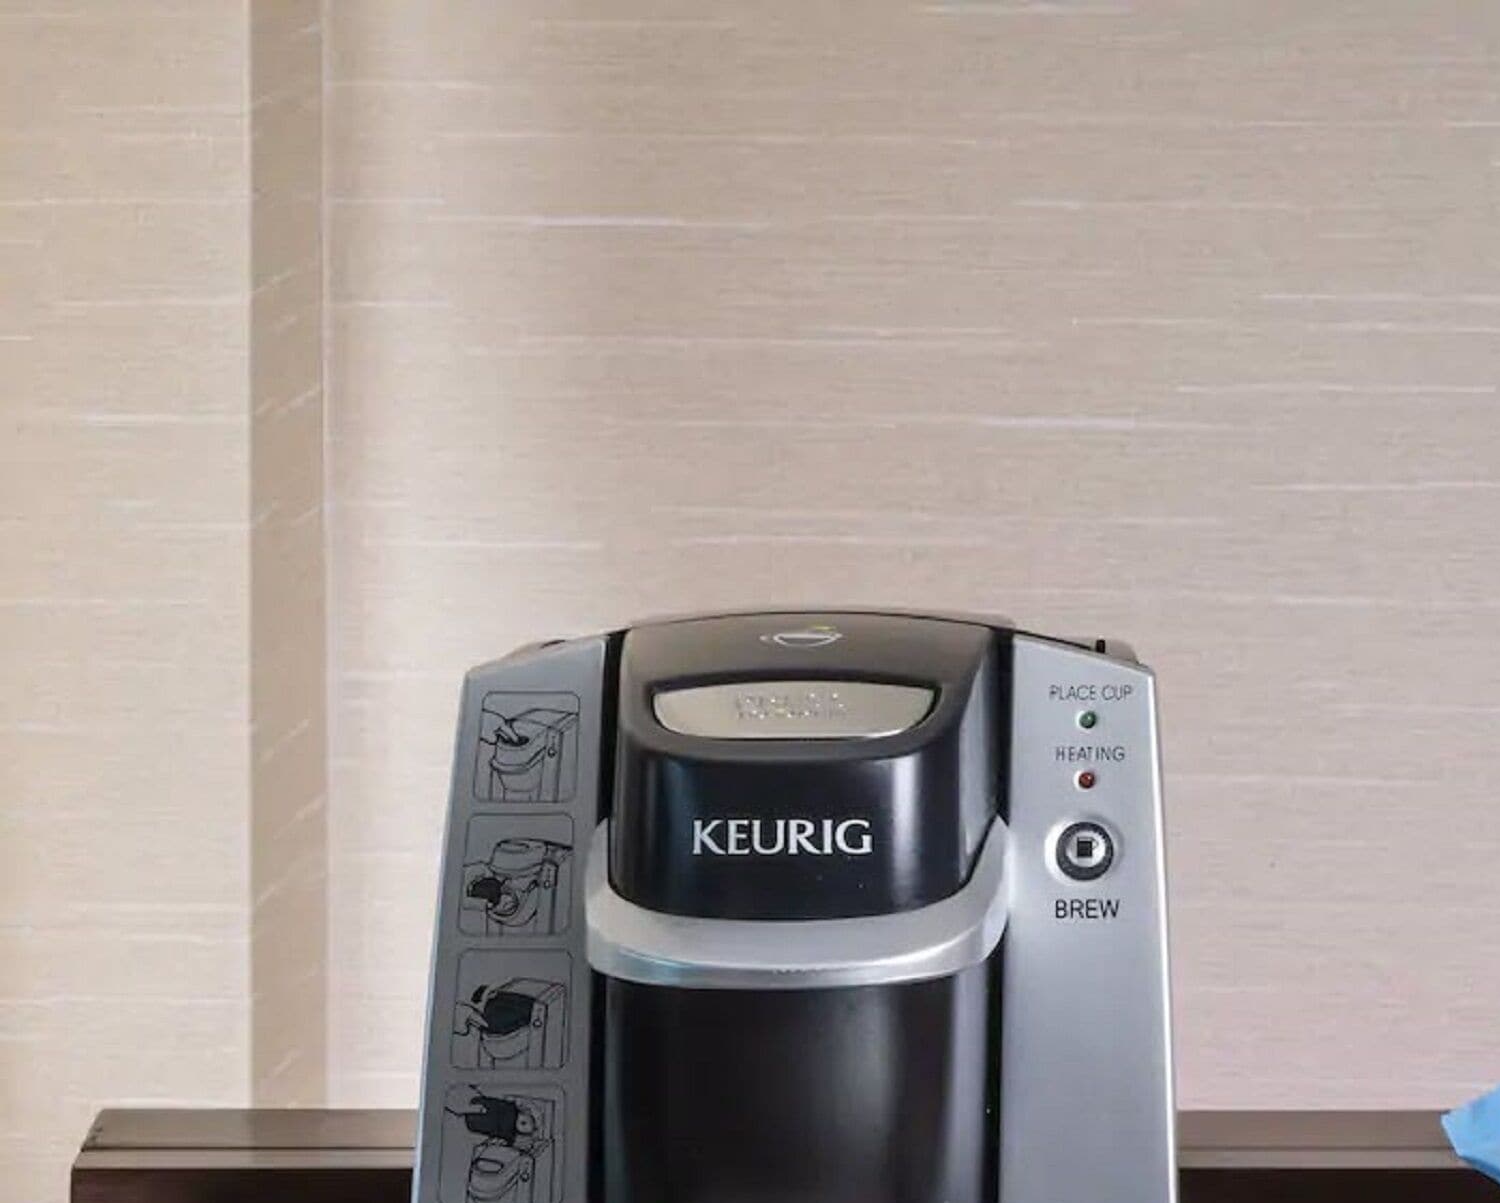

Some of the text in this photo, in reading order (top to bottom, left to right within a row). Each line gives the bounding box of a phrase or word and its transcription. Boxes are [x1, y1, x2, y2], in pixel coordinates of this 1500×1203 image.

[1049, 685, 1133, 701] PLACE CUP
[1055, 746, 1126, 763] HEATING
[692, 818, 873, 856] KEURIG
[1054, 899, 1121, 919] BREW
